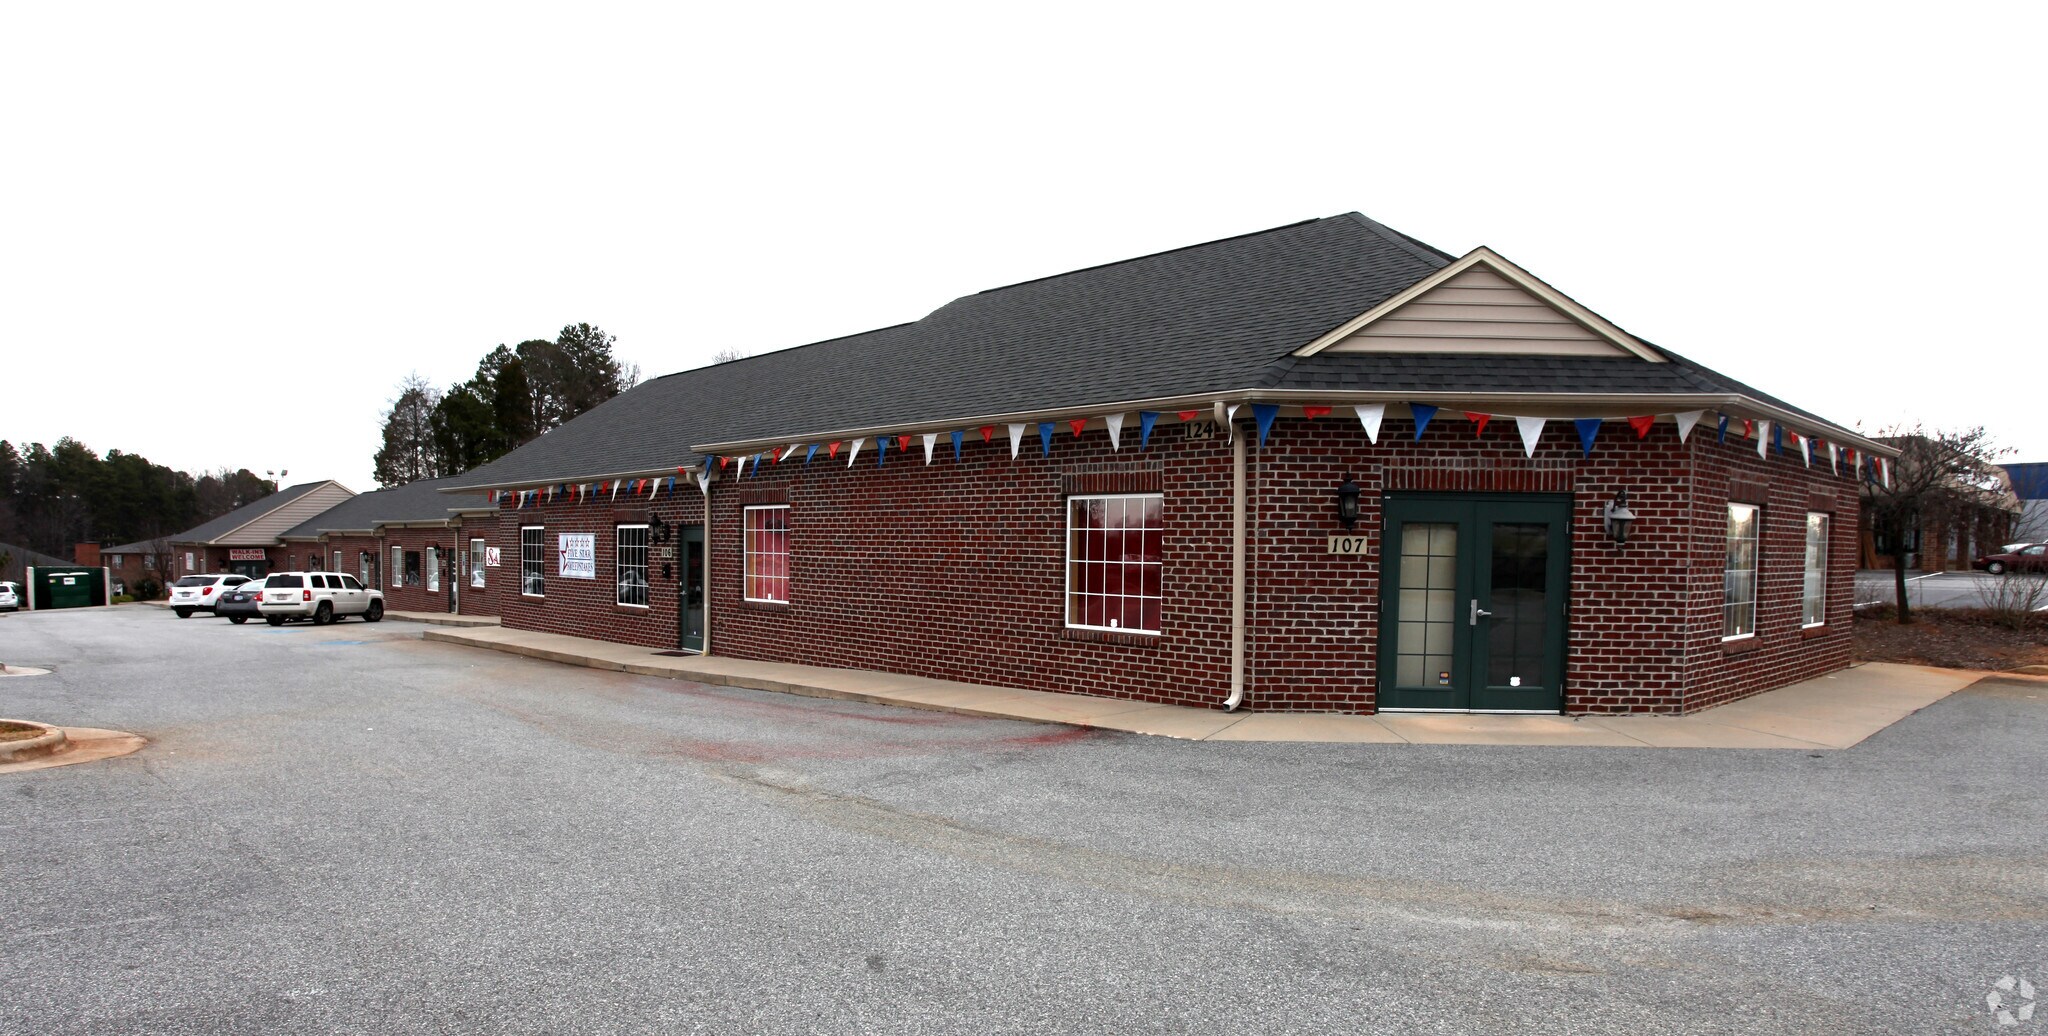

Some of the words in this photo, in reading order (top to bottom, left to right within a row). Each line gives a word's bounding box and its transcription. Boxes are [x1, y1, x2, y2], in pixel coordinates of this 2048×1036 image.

[1185, 420, 1214, 439] 124
[1332, 537, 1365, 553] 107
[567, 549, 579, 558] FIVE
[579, 549, 592, 559] STAR
[662, 548, 671, 557] 106
